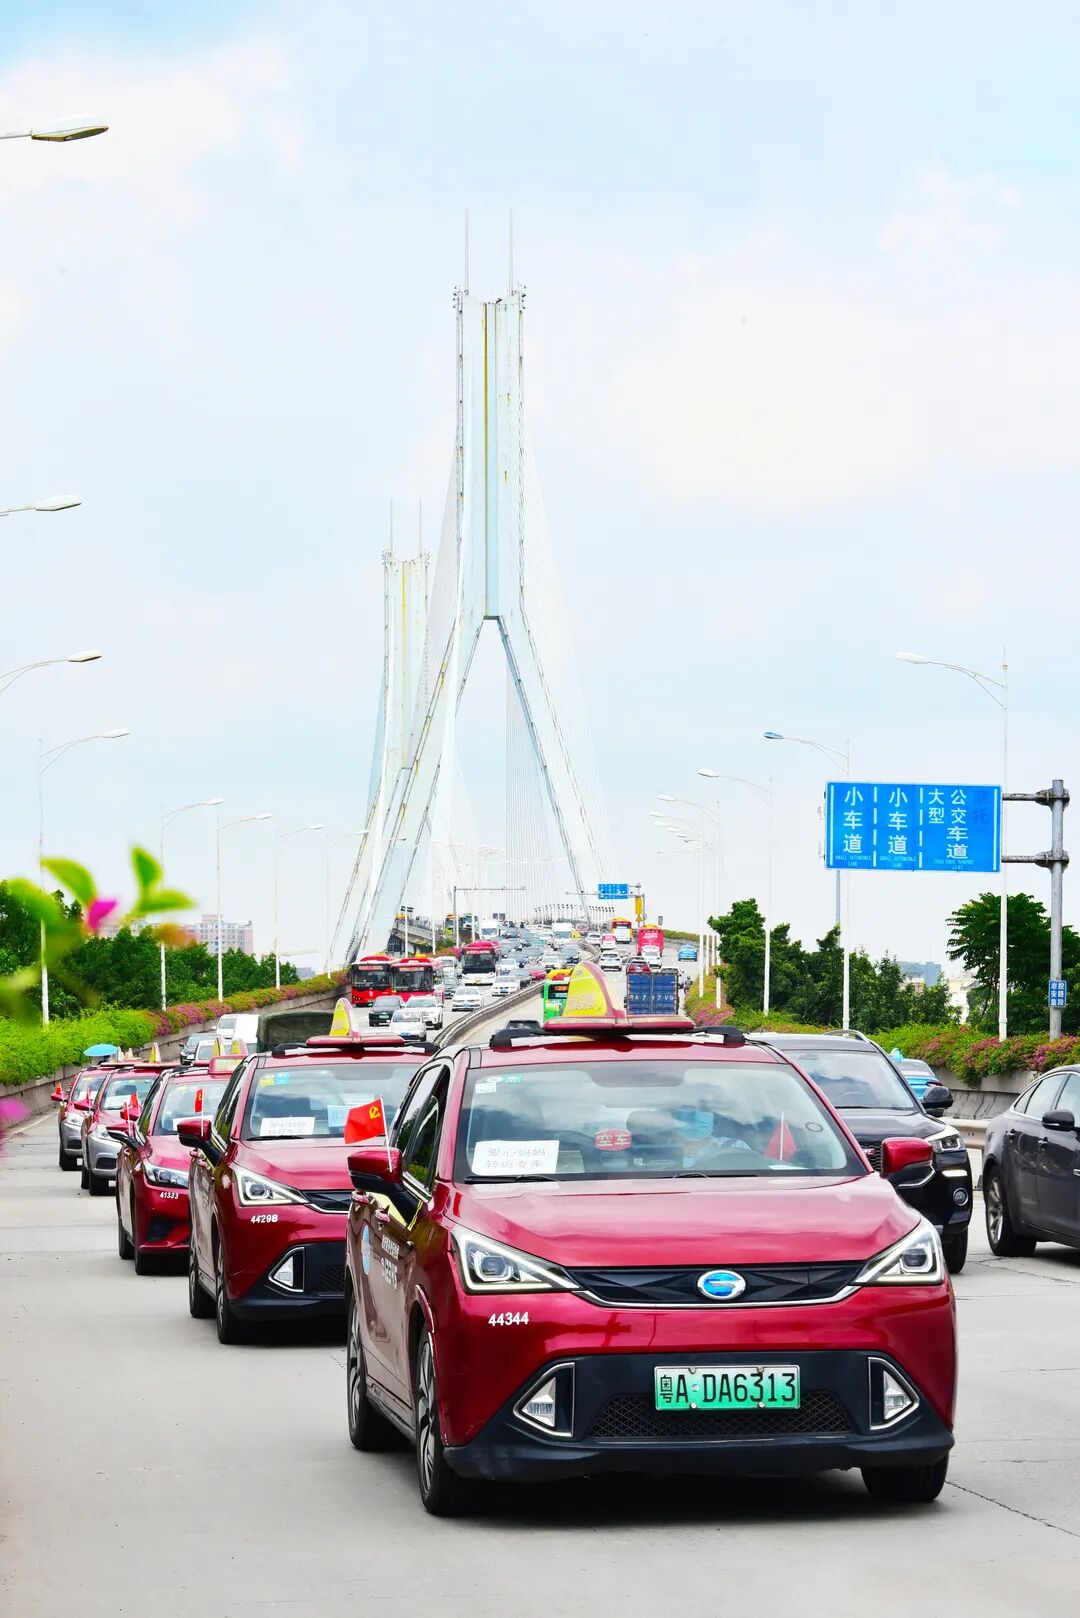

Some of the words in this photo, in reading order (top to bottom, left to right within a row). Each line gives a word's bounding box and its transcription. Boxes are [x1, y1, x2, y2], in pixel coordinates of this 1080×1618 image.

[843, 786, 863, 854] 小车道
[888, 787, 908, 855] 小车道
[928, 788, 944, 824] 大型
[250, 1213, 279, 1224] 44298
[488, 1311, 530, 1326] 44344
[702, 1373, 796, 1403] DA6313
